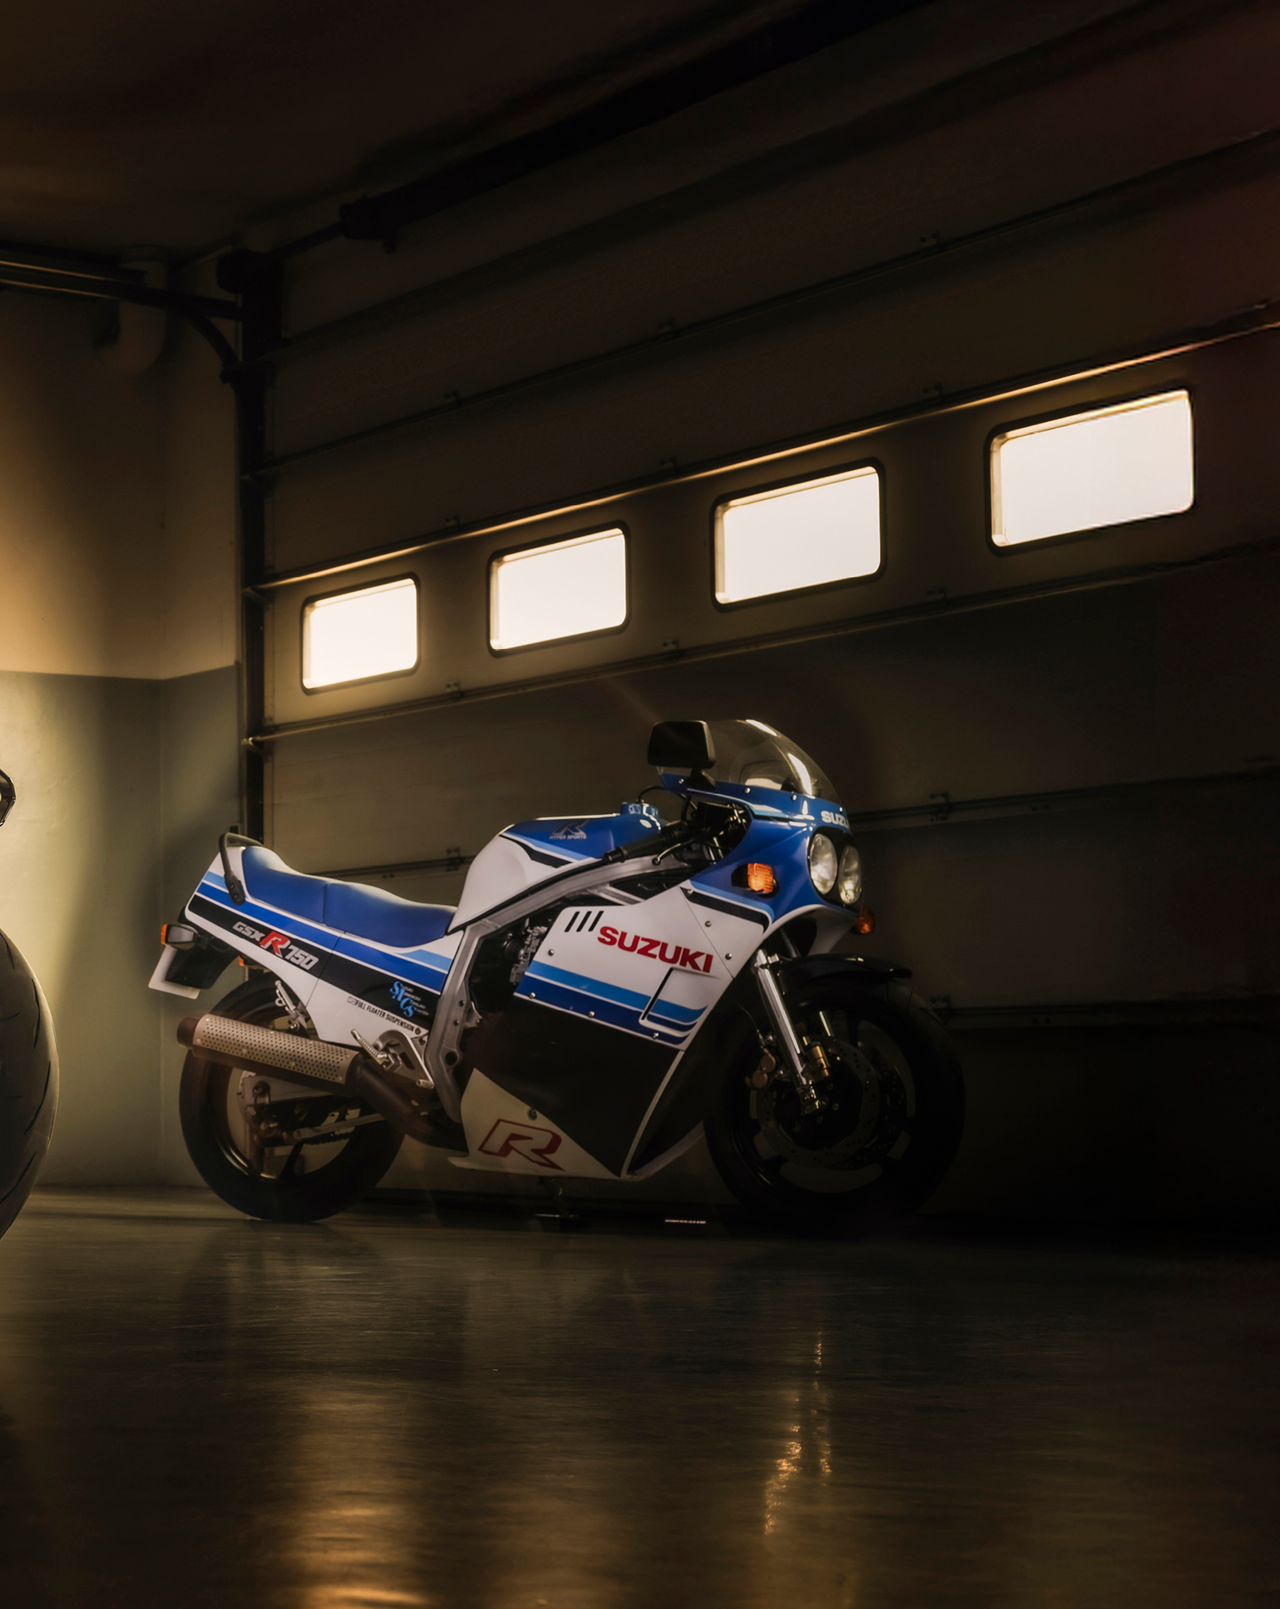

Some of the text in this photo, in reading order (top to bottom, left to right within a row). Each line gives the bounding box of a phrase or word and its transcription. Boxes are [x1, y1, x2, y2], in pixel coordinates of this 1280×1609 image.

[597, 925, 714, 974] SUZUKI
[355, 999, 367, 1010] FULL
[366, 1005, 386, 1018] FLOATER
[386, 1014, 416, 1032] SUSPENSION
[477, 1118, 566, 1172] R
